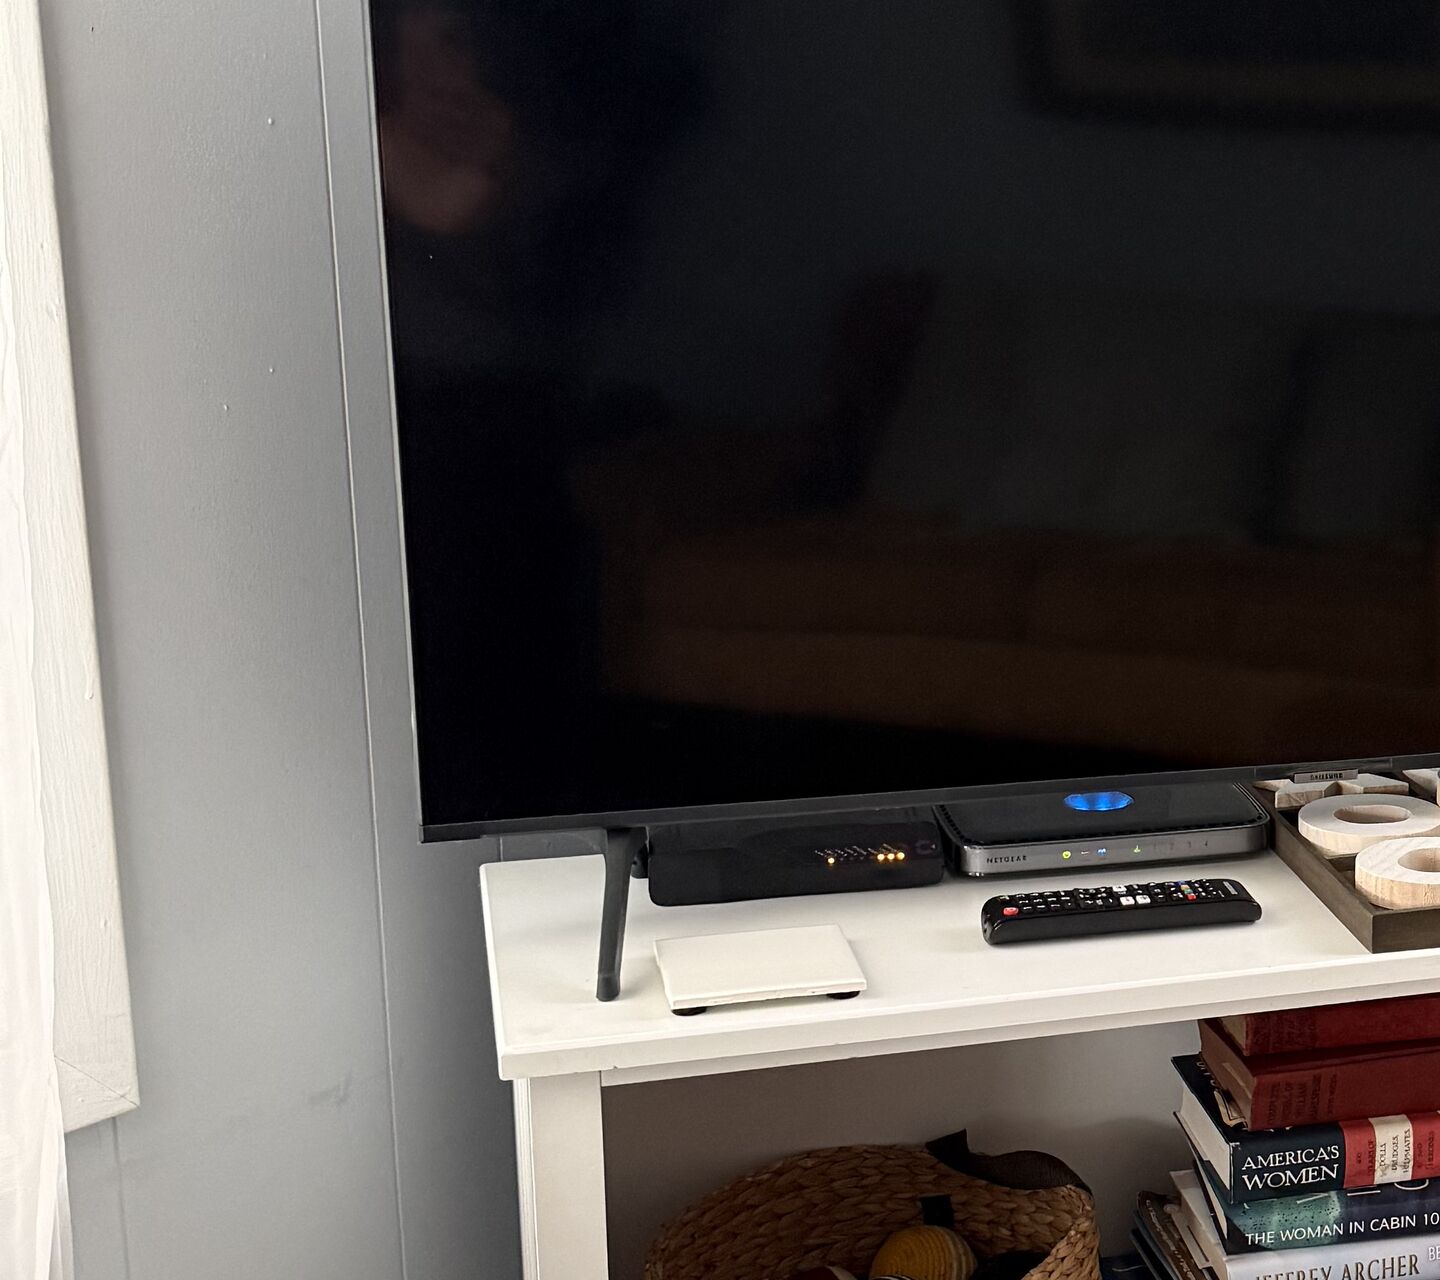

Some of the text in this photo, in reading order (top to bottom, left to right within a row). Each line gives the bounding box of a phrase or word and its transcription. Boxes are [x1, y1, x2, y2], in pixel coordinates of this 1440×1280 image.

[986, 855, 1027, 864] NETGEAR
[1242, 1144, 1341, 1171] AMERICA'S
[1242, 1163, 1340, 1191] WOMEN
[1245, 1212, 1440, 1246] THE WOMAN IN CABIN 10
